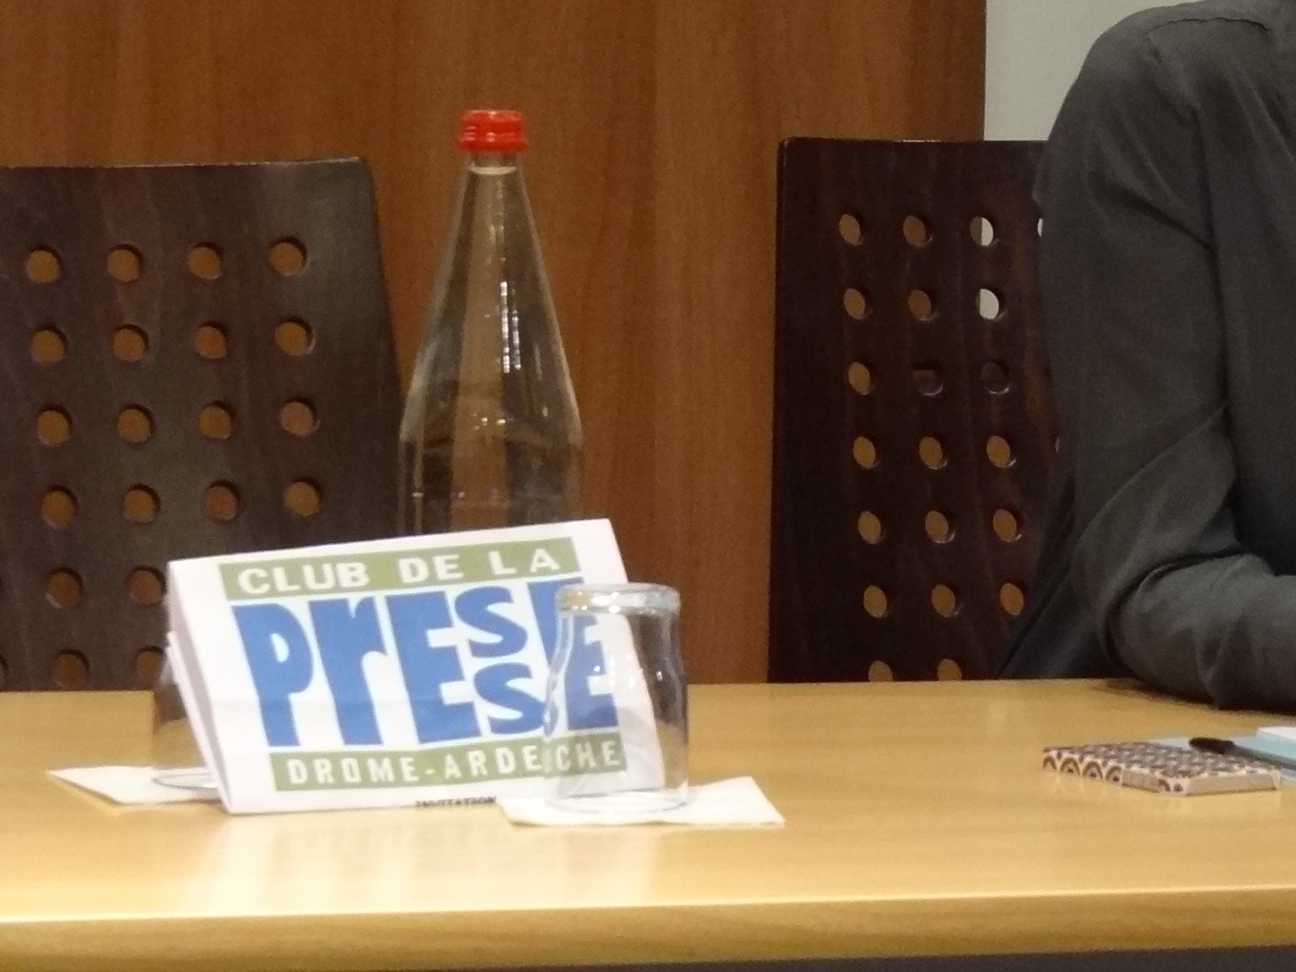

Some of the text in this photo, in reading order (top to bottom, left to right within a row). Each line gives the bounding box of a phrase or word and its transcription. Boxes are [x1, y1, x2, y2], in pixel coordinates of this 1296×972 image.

[238, 548, 561, 594] CLUB DE LA
